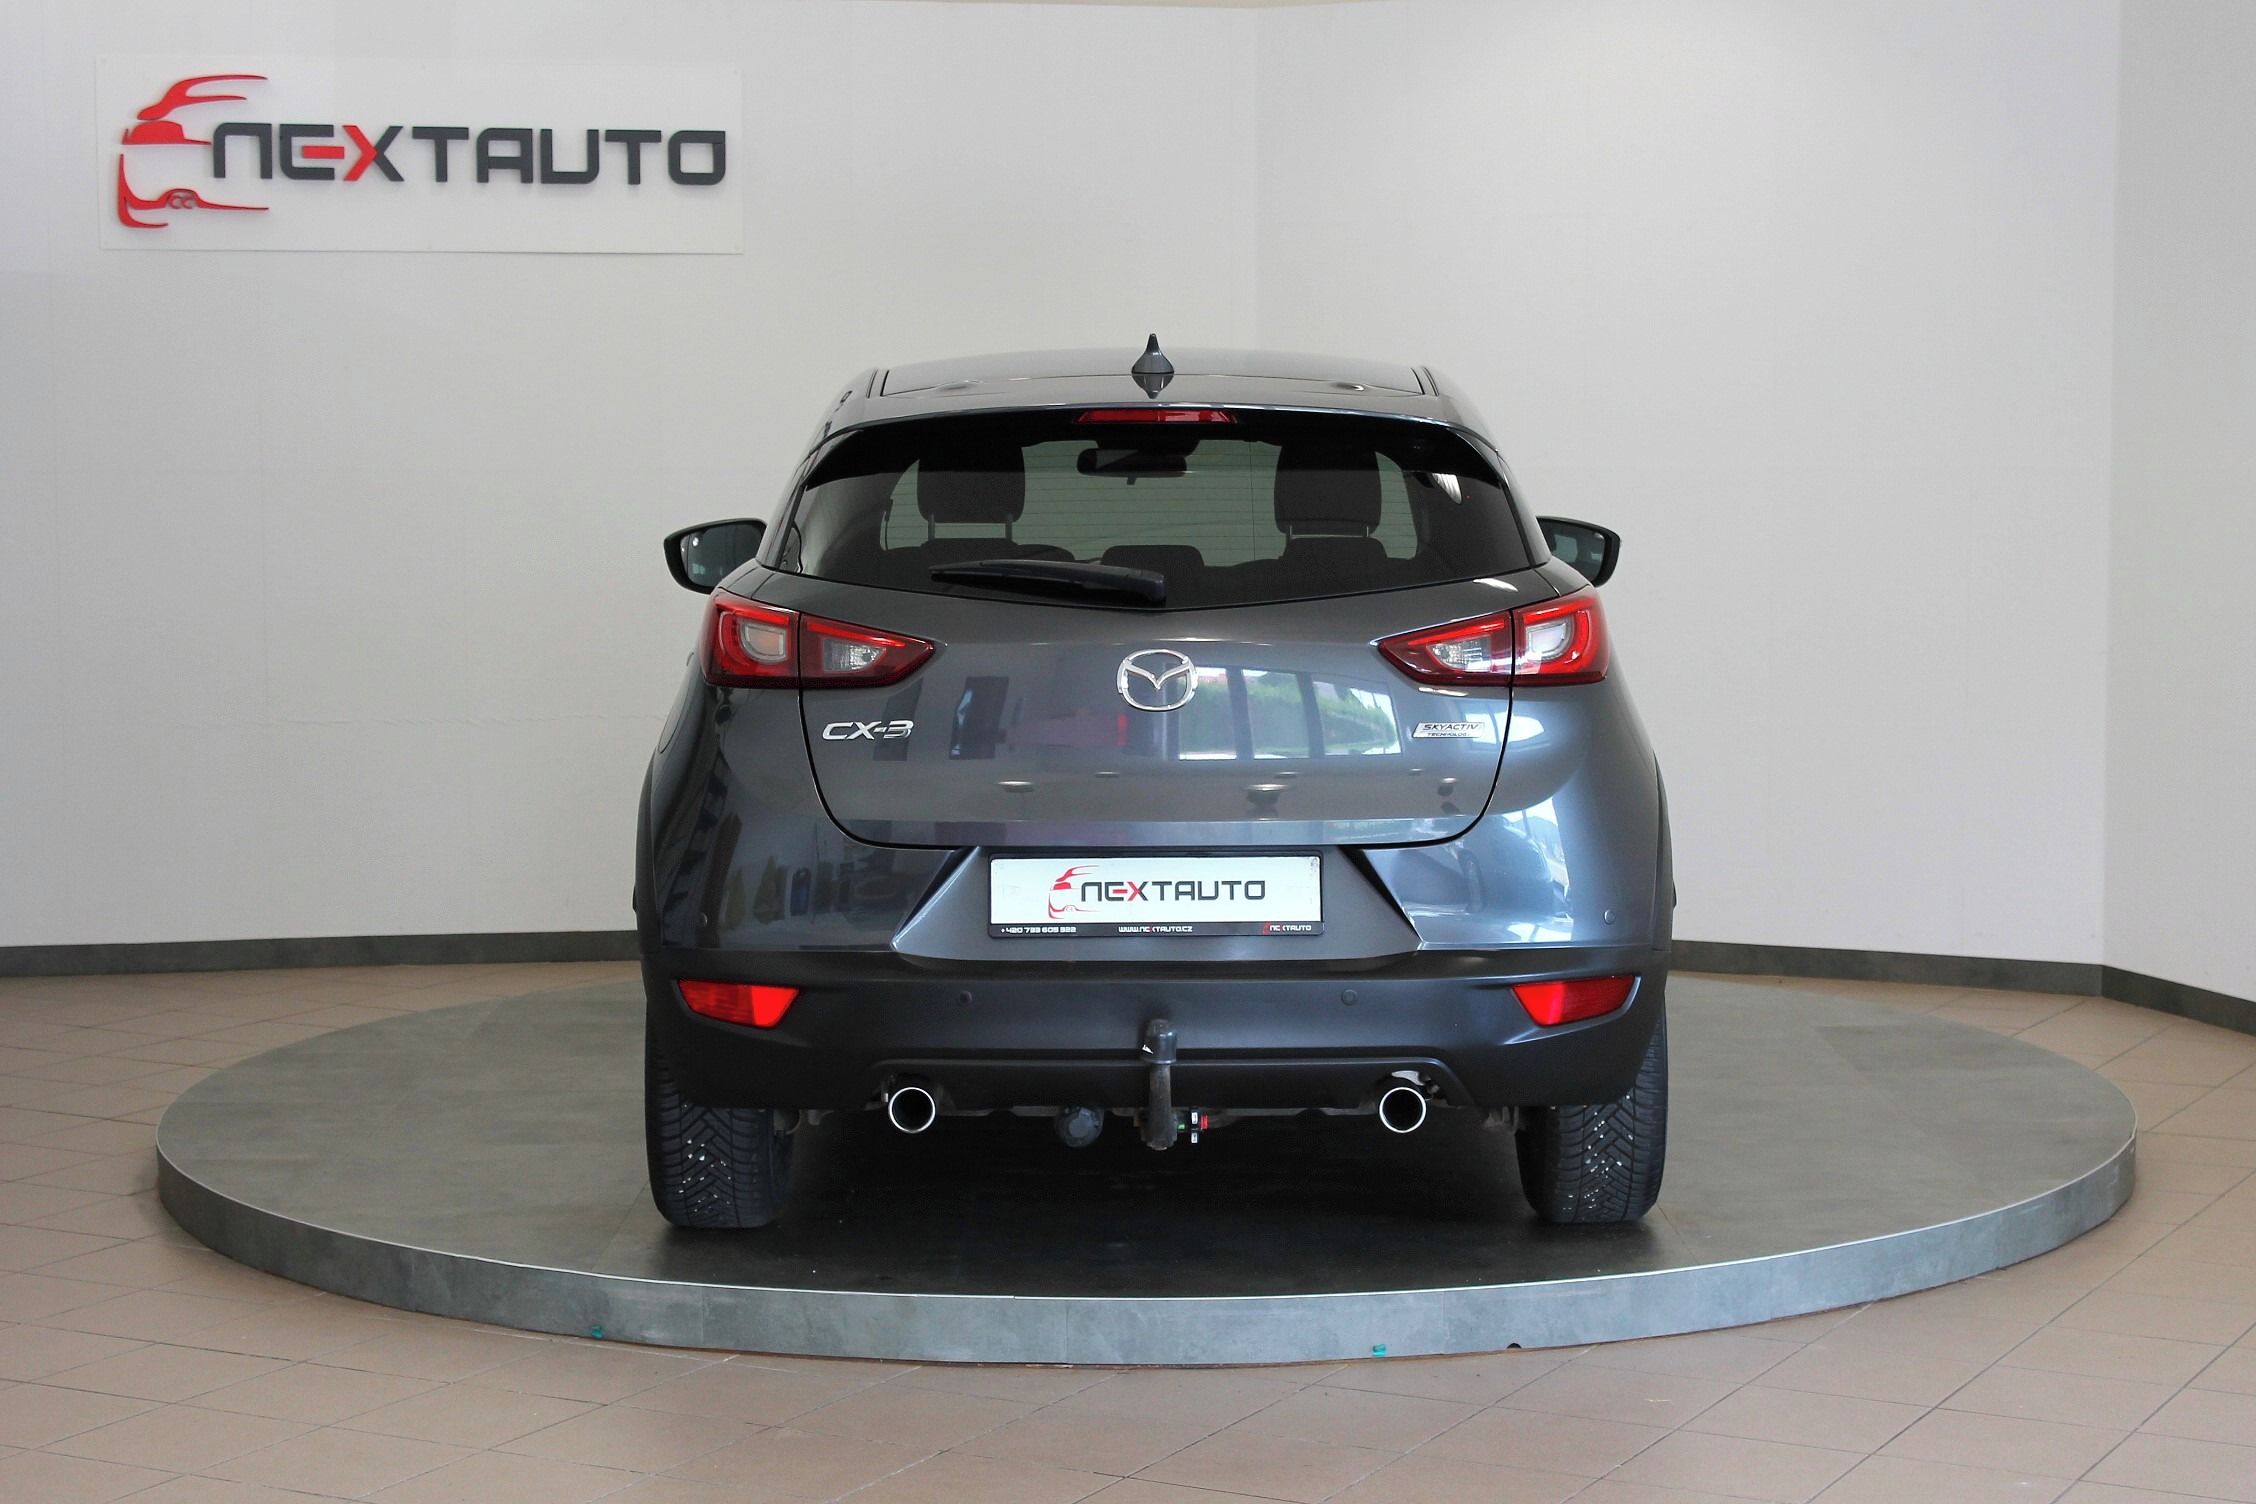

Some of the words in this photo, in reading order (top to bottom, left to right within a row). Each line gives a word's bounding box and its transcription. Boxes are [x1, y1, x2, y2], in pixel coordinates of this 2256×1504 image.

[212, 122, 727, 187] NEXTAUTO
[822, 719, 914, 741] CX-3
[1422, 723, 1479, 731] SKYACTIV
[1080, 879, 1266, 902] NEXTAUTO
